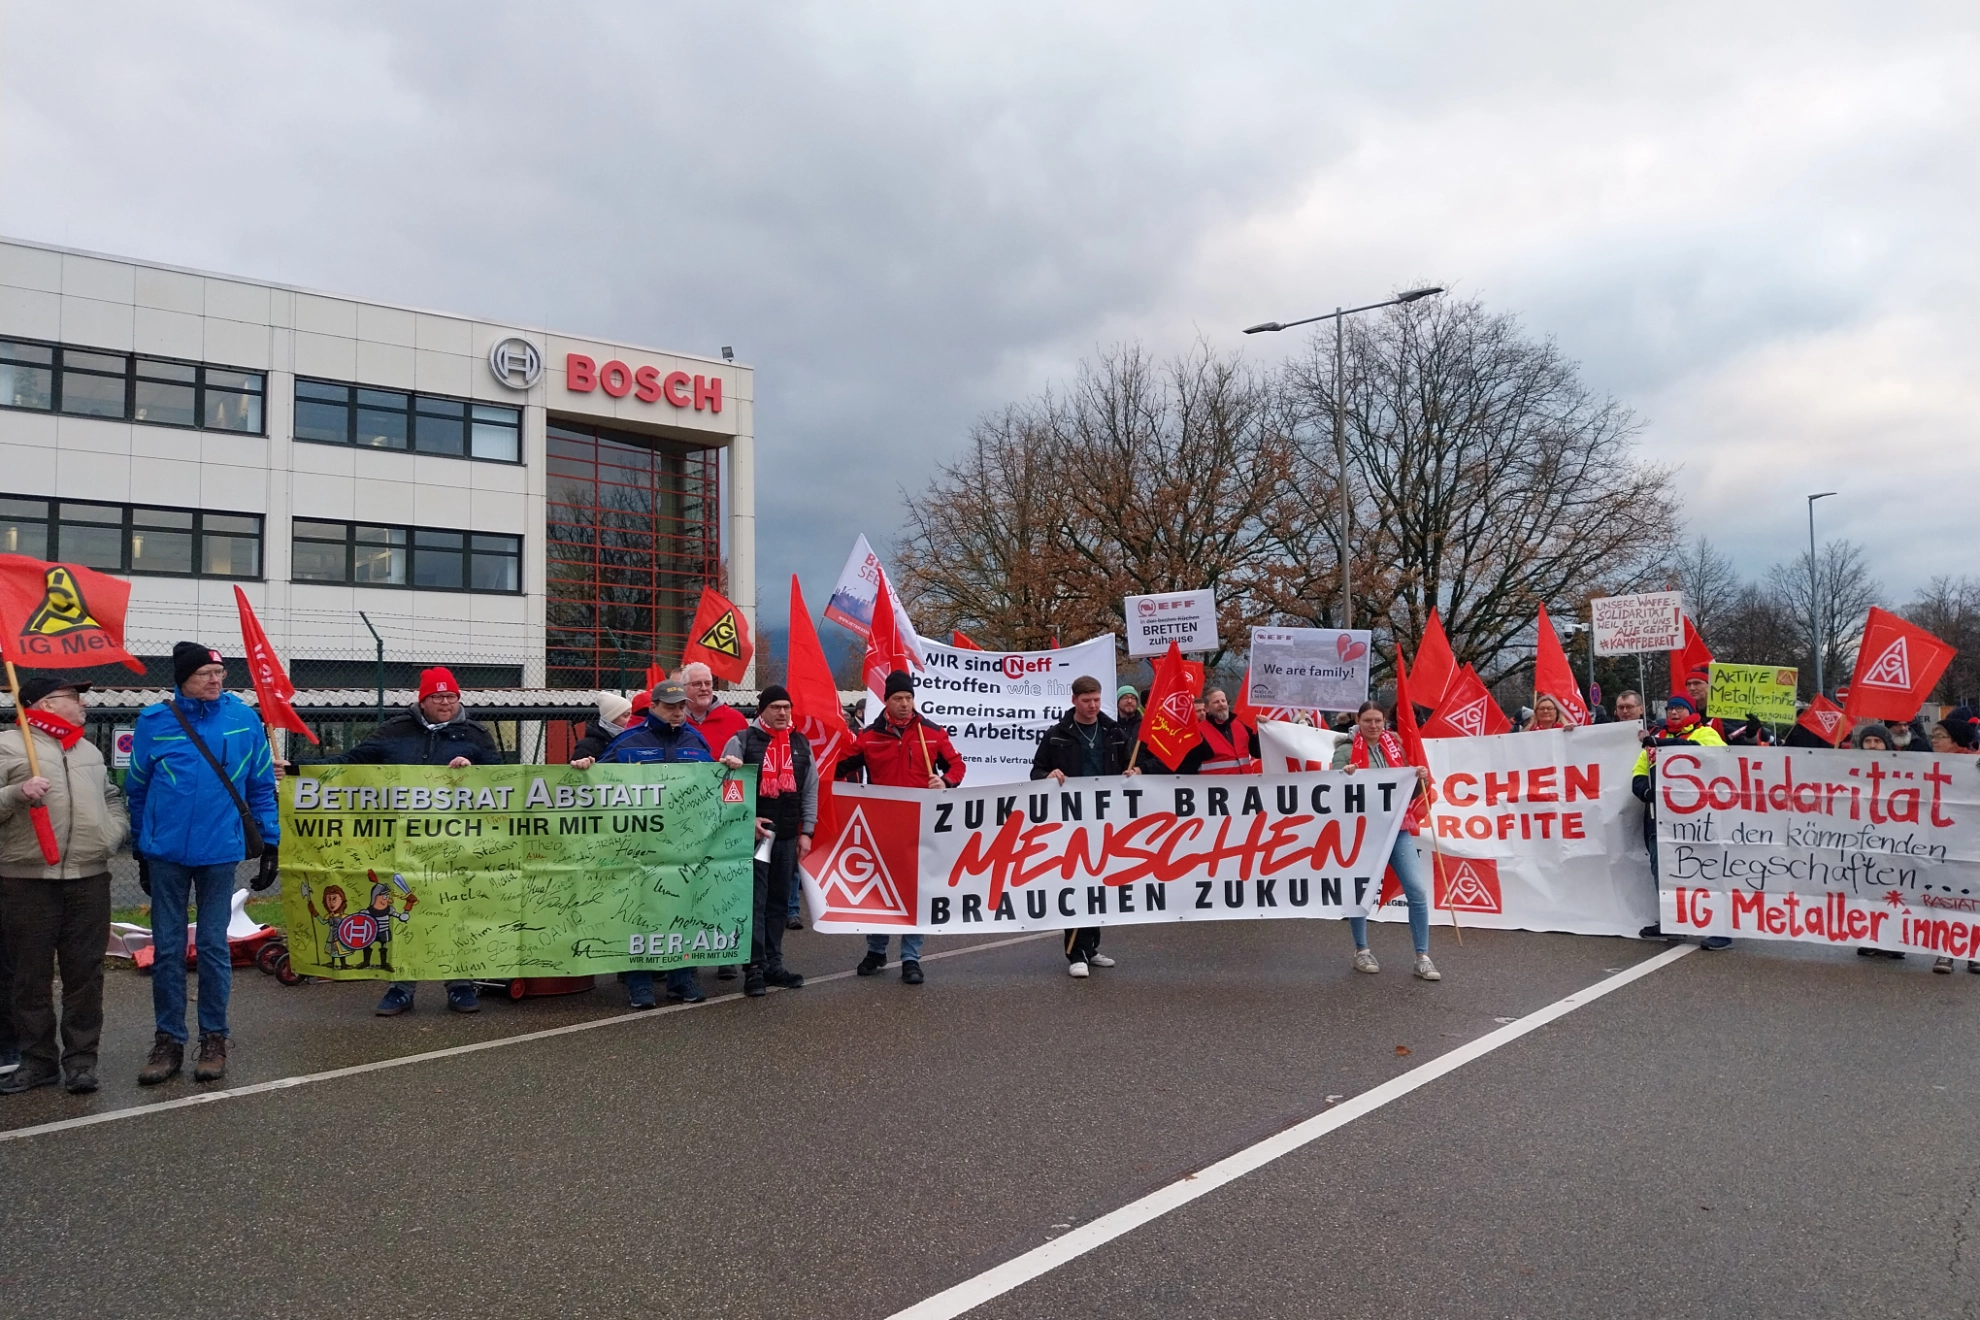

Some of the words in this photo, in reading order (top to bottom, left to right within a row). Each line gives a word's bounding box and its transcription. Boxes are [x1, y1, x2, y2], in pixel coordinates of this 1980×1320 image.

[567, 353, 722, 413] BOSCH
[1596, 599, 1636, 611] UNSERE
[1143, 622, 1198, 636] BRETTEN
[1597, 620, 1620, 629] WEIL
[1652, 617, 1672, 625] UNS
[1642, 625, 1673, 634] GEHT
[19, 636, 52, 655] IG
[61, 633, 121, 655] Met
[1149, 635, 1193, 646] zuhause
[964, 656, 1003, 673] sind
[1007, 656, 1052, 675] Neff
[1263, 664, 1283, 675] We
[1286, 667, 1306, 676] are
[1310, 665, 1355, 681] family!
[911, 672, 1001, 694] betroffen
[1006, 680, 1042, 696] wie
[920, 701, 1036, 719] Gemeinsam
[1043, 706, 1068, 720] fü
[964, 723, 1055, 746] Arbeitsp
[985, 755, 997, 764] als
[294, 777, 515, 811] BETRIEBSRAT
[526, 777, 667, 809] ABSTATT
[1662, 754, 1956, 828] Solidarität
[934, 787, 1145, 833] ZUKUNFT
[1175, 781, 1398, 818] BRAUCHT
[294, 818, 343, 837] WIR
[353, 818, 397, 837] MIT
[406, 818, 482, 837] EUCH
[509, 817, 550, 836] IHR
[560, 815, 603, 835] MIT
[612, 814, 665, 833] UNS
[1673, 812, 1714, 842] mit
[1731, 821, 1773, 845] den
[1786, 813, 1947, 863] kämpfenden
[948, 811, 1368, 911] MENSCHEN
[930, 882, 1168, 926] BRAUCHEN
[1675, 887, 1713, 929] IG
[629, 956, 645, 964] WIR
[662, 955, 683, 964] EUCH
[691, 952, 706, 960] IHR
[707, 951, 721, 959] MIT
[722, 950, 739, 959] UNS
